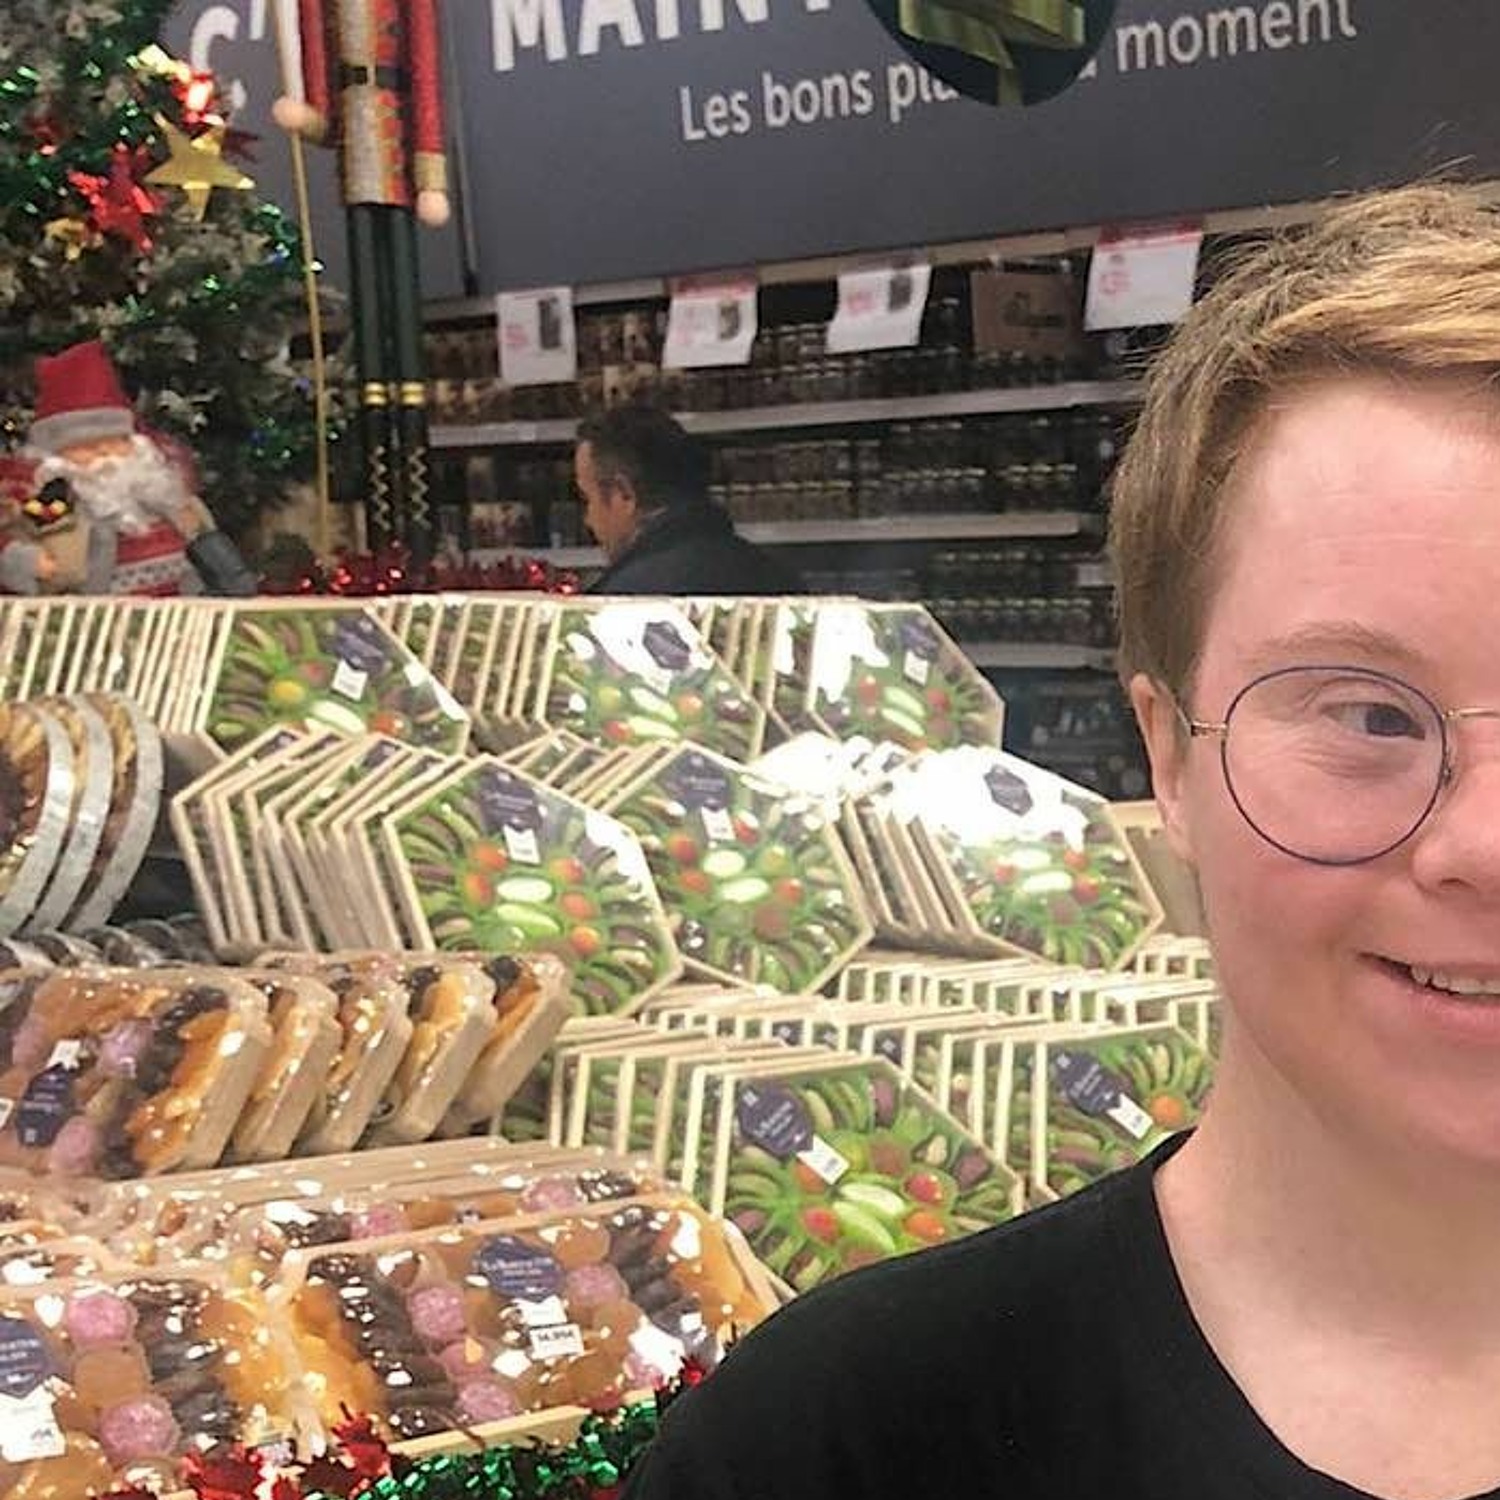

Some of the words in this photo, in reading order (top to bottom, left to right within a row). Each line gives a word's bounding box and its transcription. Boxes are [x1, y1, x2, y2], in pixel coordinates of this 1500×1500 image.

[681, 86, 750, 140] Les
[763, 69, 873, 127] bons
[1116, 0, 1357, 72] moment
